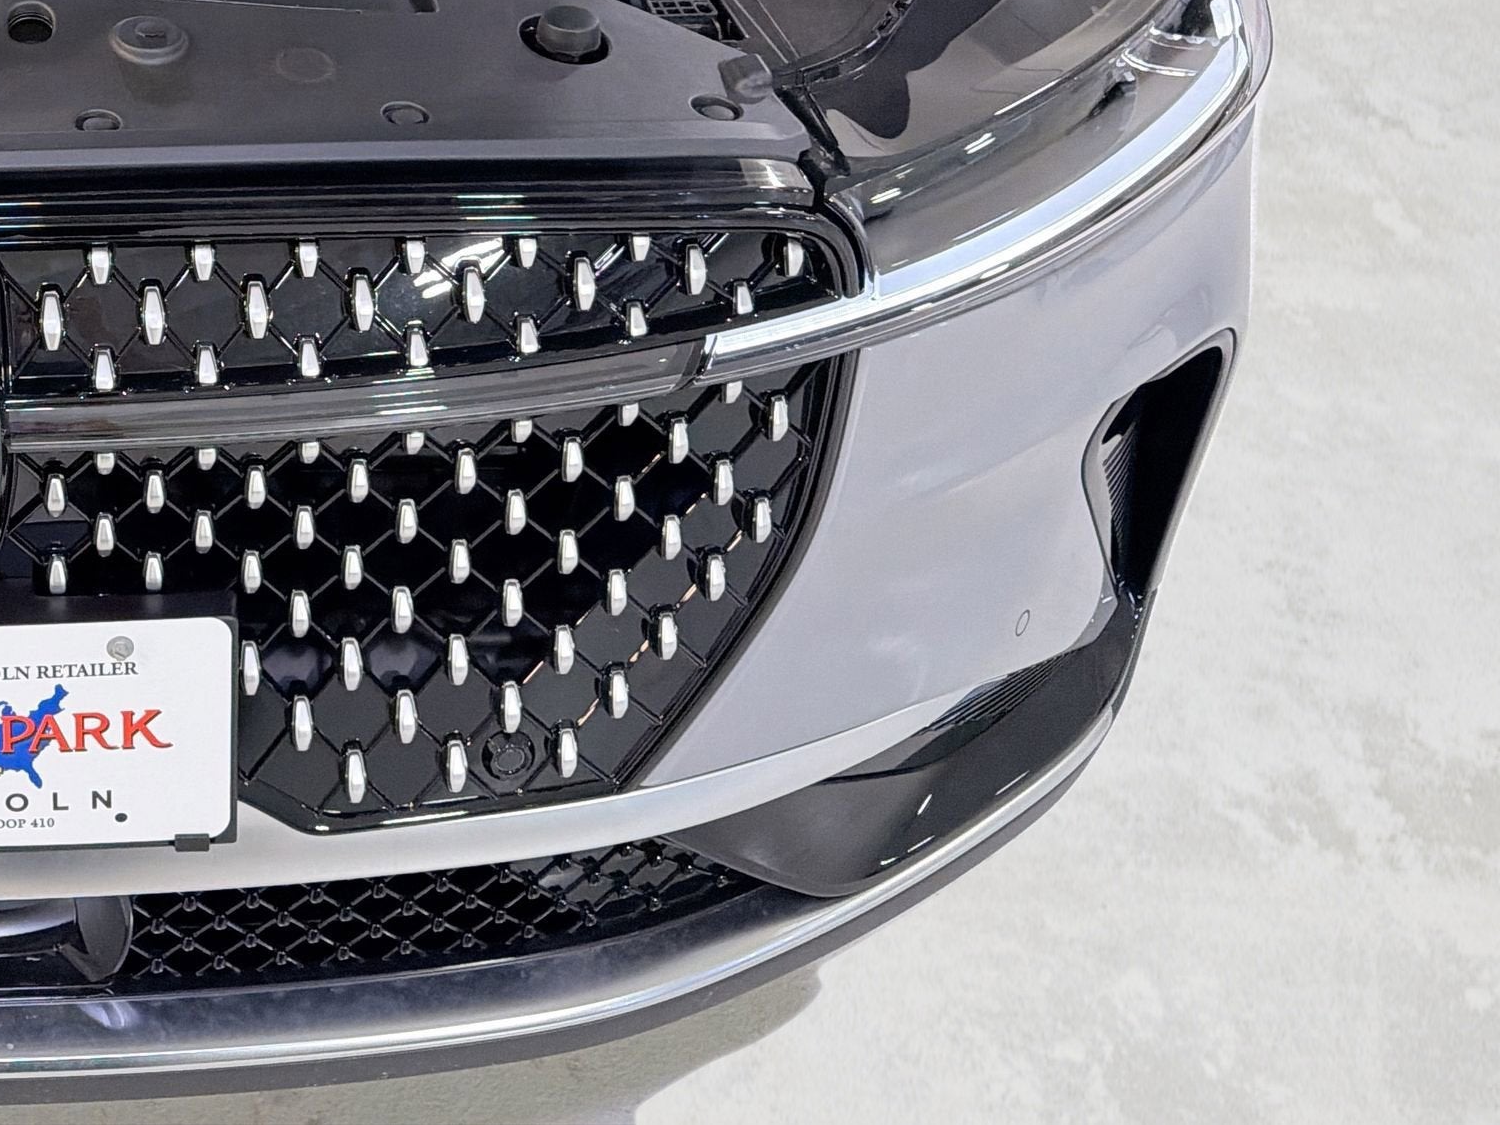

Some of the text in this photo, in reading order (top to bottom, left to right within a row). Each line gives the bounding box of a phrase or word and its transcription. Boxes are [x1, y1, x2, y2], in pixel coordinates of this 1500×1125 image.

[36, 661, 139, 679] RETAILER
[0, 709, 174, 755] PARK
[30, 817, 55, 828] 410
